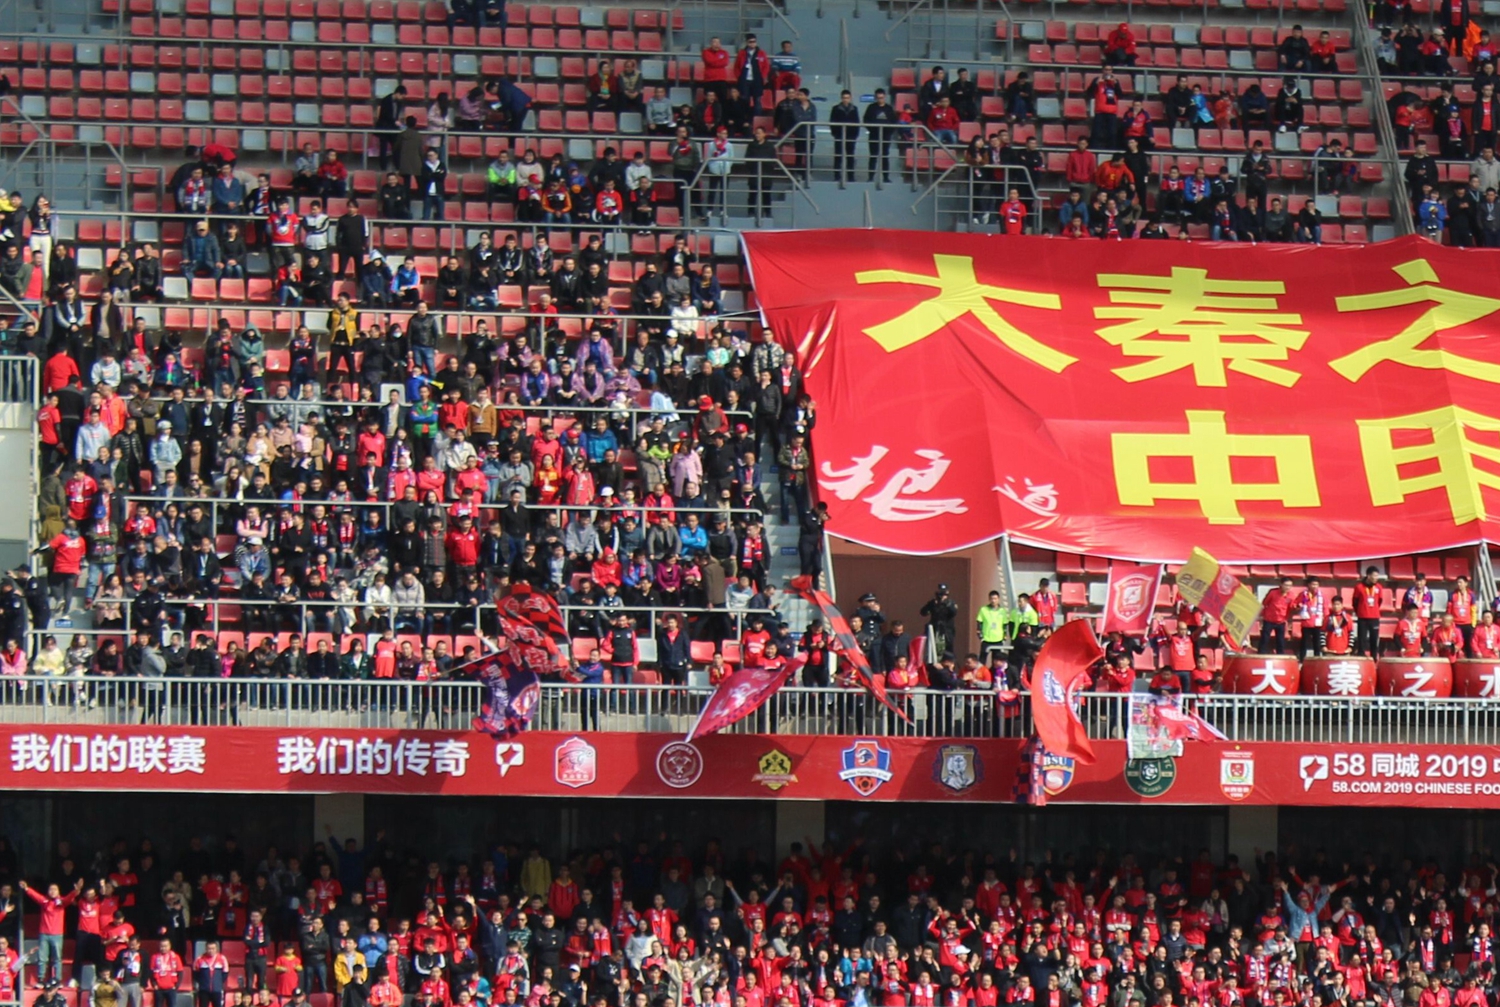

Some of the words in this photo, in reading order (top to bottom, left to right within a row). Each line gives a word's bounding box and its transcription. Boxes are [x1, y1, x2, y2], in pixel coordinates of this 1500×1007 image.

[11, 734, 206, 774] 我们的联赛
[277, 737, 470, 777] 我们的传奇
[1333, 754, 1365, 776] 58
[1371, 754, 1419, 778] 同城
[1426, 755, 1487, 778] 2019
[1332, 782, 1381, 793] 58.COM
[1384, 782, 1412, 793] 2019
[1415, 783, 1471, 794] CHINESE
